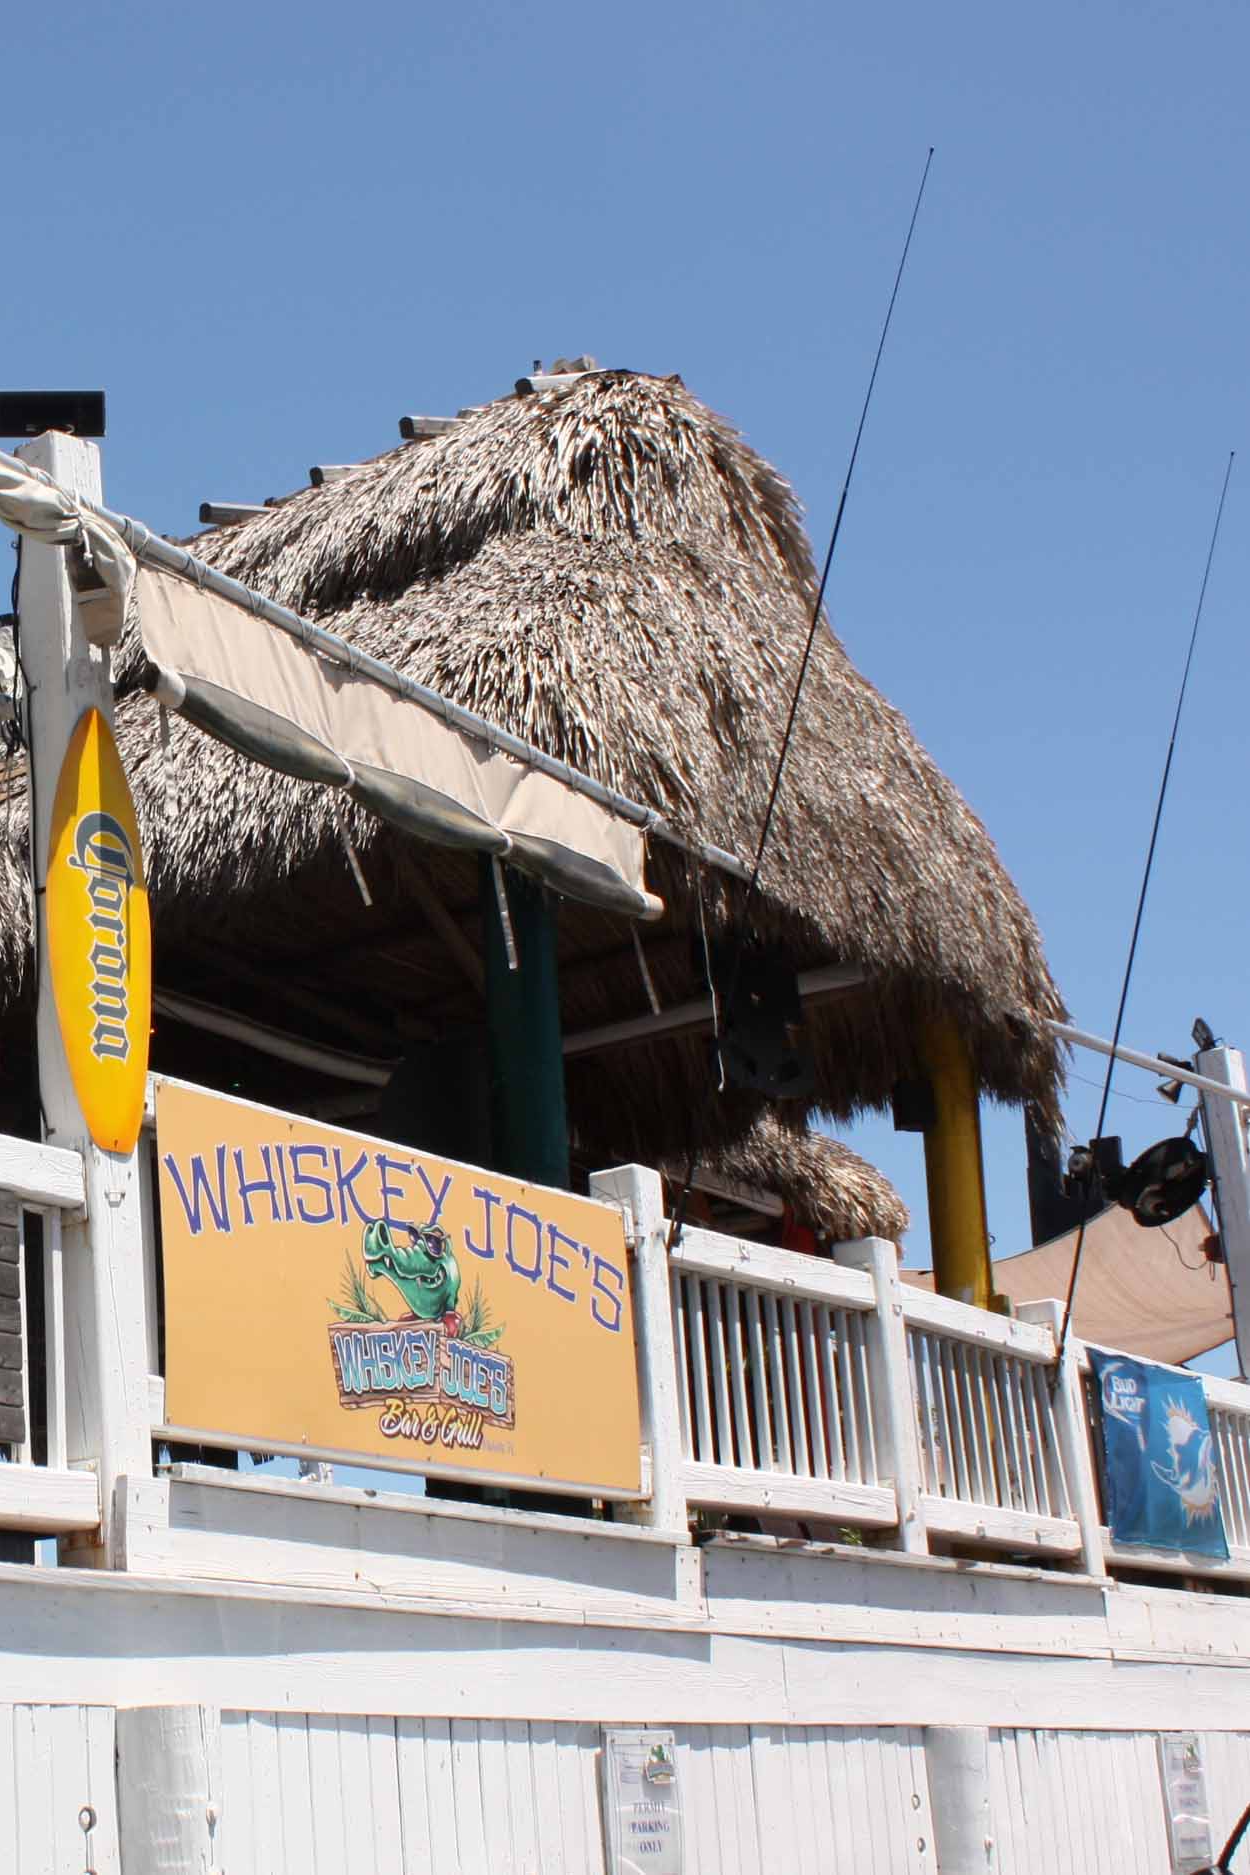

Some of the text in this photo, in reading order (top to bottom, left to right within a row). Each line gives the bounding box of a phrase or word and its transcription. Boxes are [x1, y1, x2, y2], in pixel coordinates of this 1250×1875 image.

[66, 810, 135, 1064] Corona
[163, 1144, 625, 1333] WHISKEY JOE'S
[334, 1331, 508, 1415] WHISKEY JOE'S
[380, 1398, 420, 1439] Bar
[421, 1404, 439, 1444] &
[440, 1406, 483, 1450] Grill
